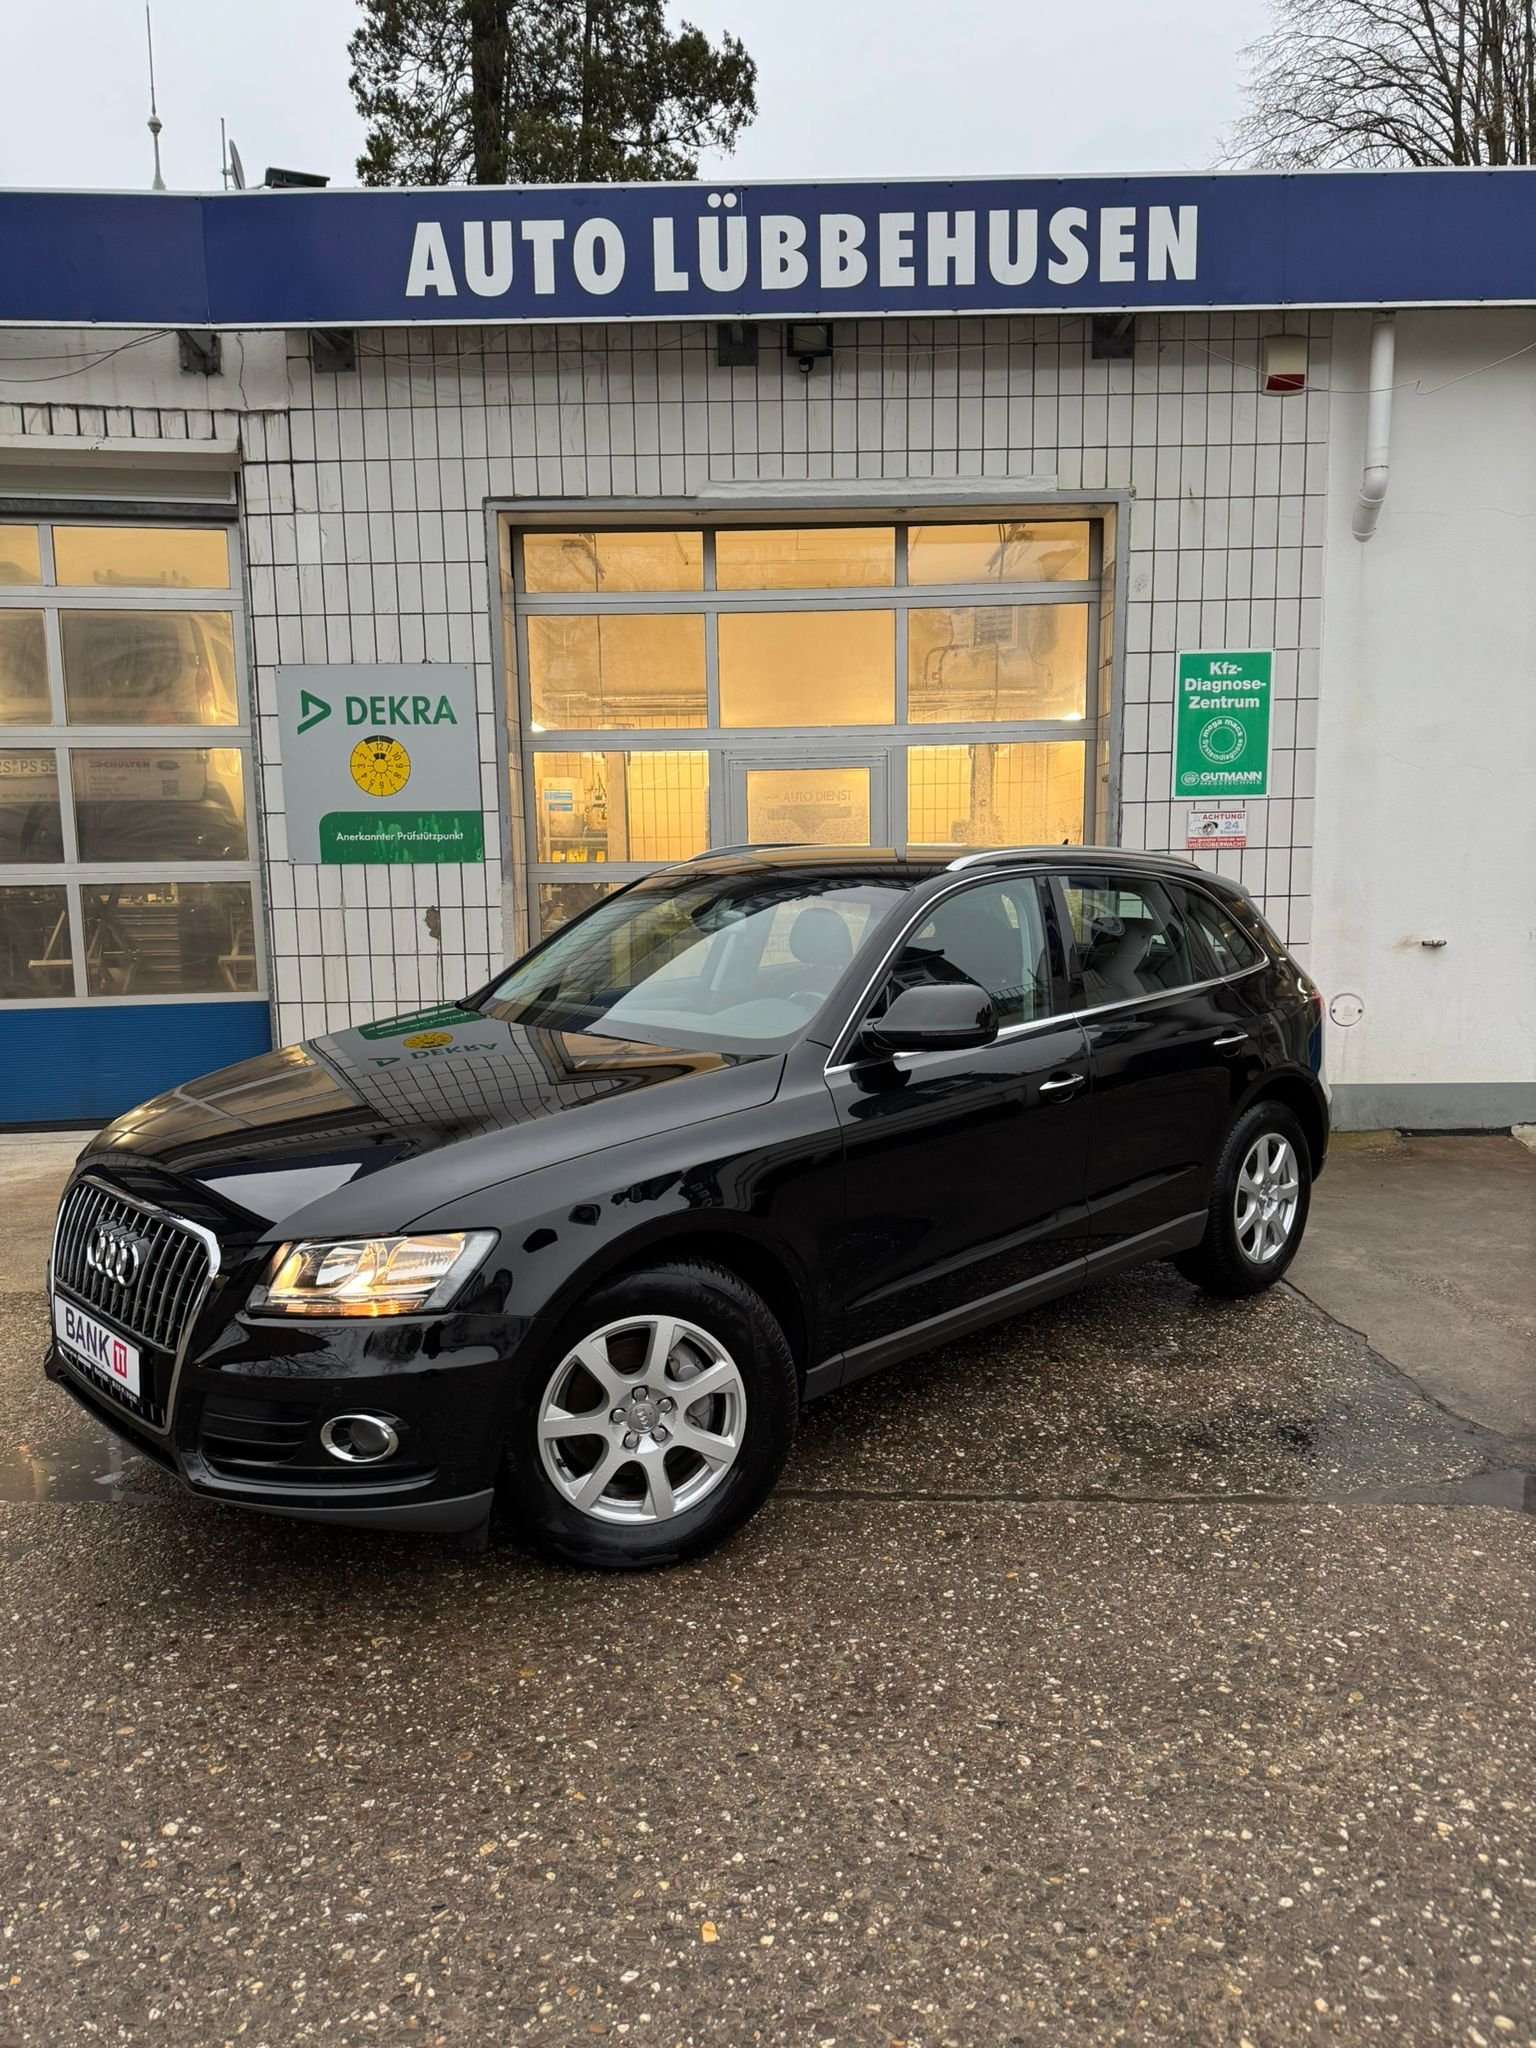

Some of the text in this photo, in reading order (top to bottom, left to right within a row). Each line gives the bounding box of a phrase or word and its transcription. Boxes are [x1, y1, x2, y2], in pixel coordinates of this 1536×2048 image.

[405, 192, 1198, 297] AUTO LÜBBEHUSEN
[1209, 662, 1242, 675] Kfz-
[1184, 678, 1266, 693] Diagnose-
[1188, 696, 1260, 709] Zentrum
[345, 695, 458, 726] DEKRA
[0, 760, 10, 774] S
[20, 759, 38, 773] PS
[1200, 771, 1263, 781] GUTMANN
[1224, 821, 1239, 829] 24
[336, 831, 464, 843] Anerkannter Prüfstützpunkt
[65, 1306, 111, 1368] BANK
